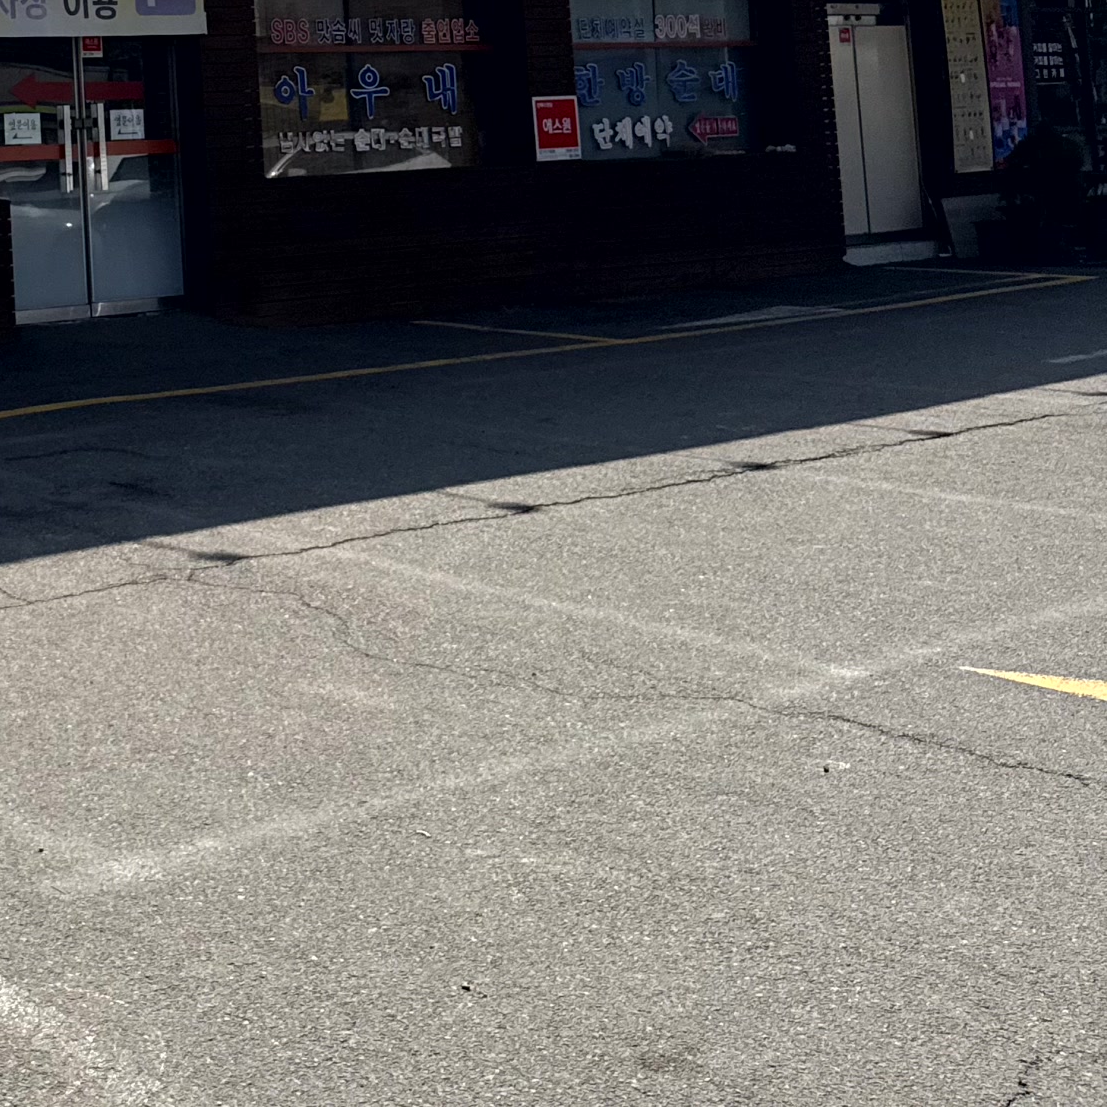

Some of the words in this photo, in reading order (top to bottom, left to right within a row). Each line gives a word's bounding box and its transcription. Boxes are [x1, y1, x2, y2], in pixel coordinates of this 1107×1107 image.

[271, 17, 310, 45] SBS
[315, 17, 363, 44] 맛솜씨
[274, 63, 458, 122] 아우내
[574, 60, 738, 107] 한방순대
[542, 117, 573, 134] 에스원
[592, 114, 674, 150] 단체예약
